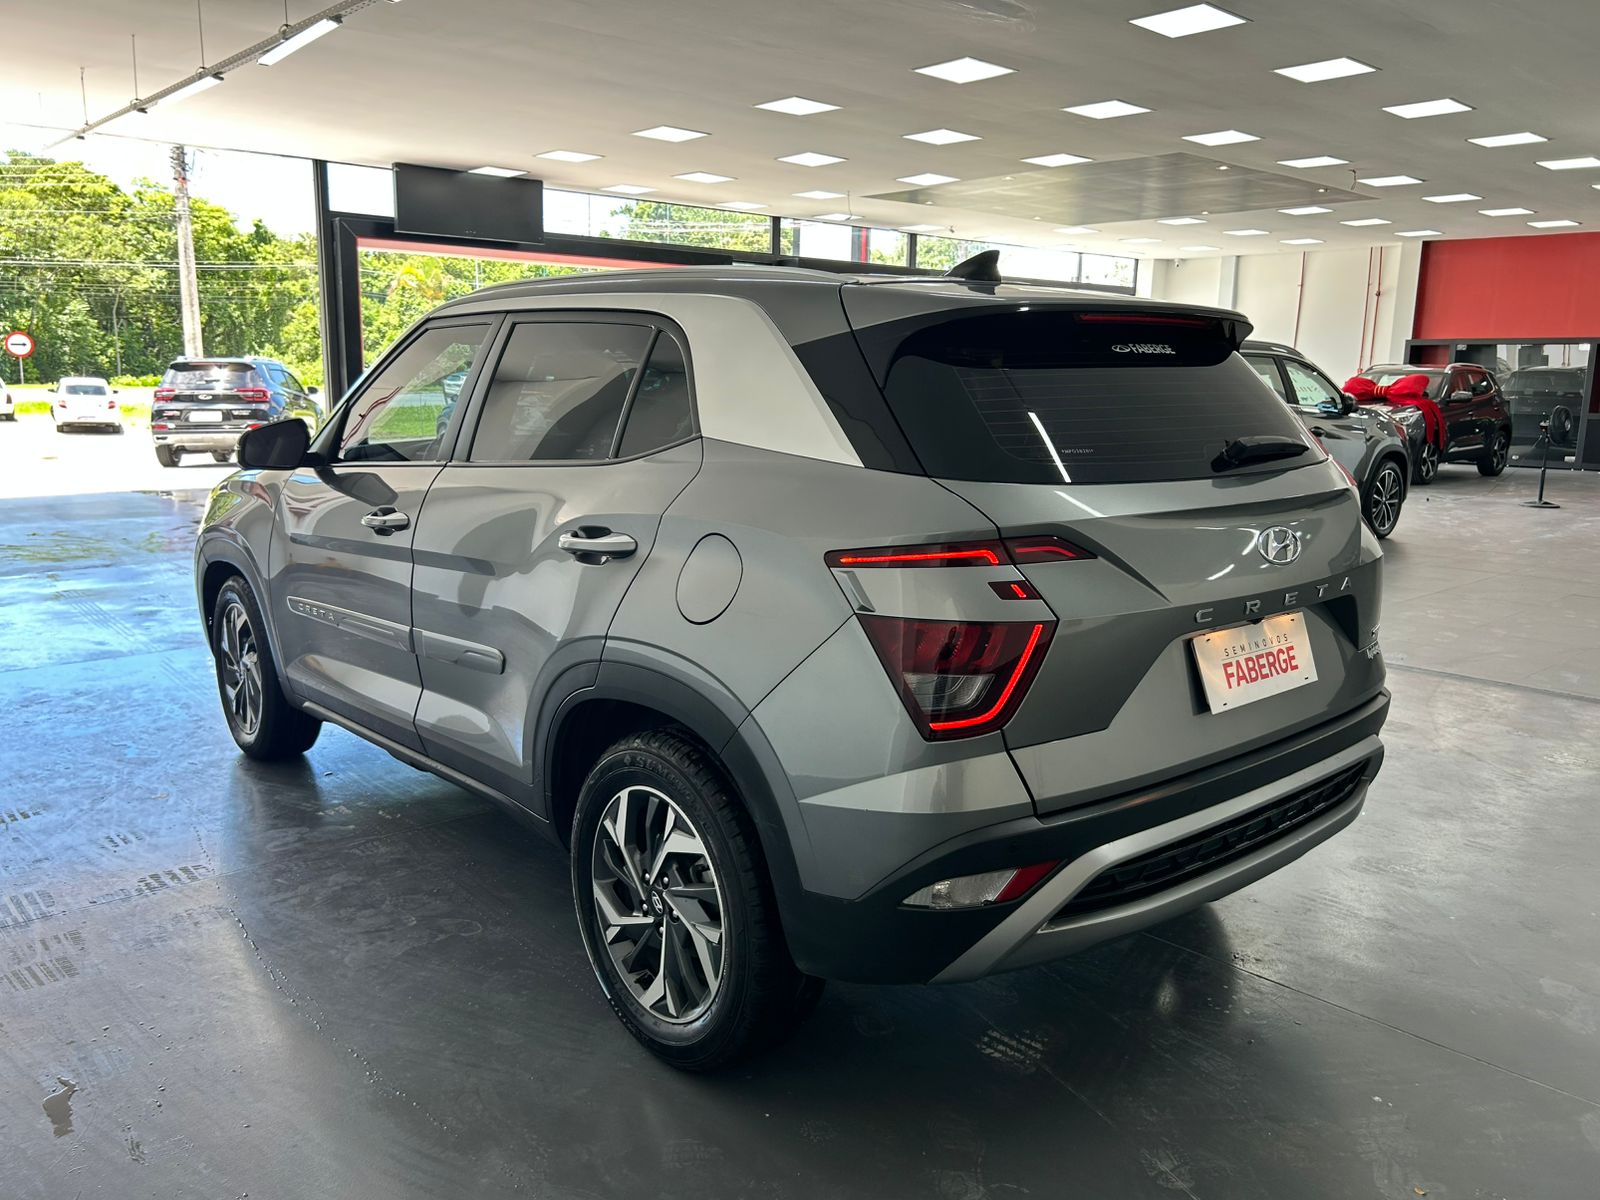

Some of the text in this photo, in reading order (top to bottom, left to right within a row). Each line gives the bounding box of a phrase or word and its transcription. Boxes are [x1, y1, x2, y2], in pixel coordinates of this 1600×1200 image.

[1128, 343, 1176, 354] FABERGE
[298, 603, 336, 621] CRETA
[1194, 576, 1352, 624] CRETA
[1224, 633, 1289, 657] SEMINOVOS
[1222, 645, 1299, 689] FABERGE
